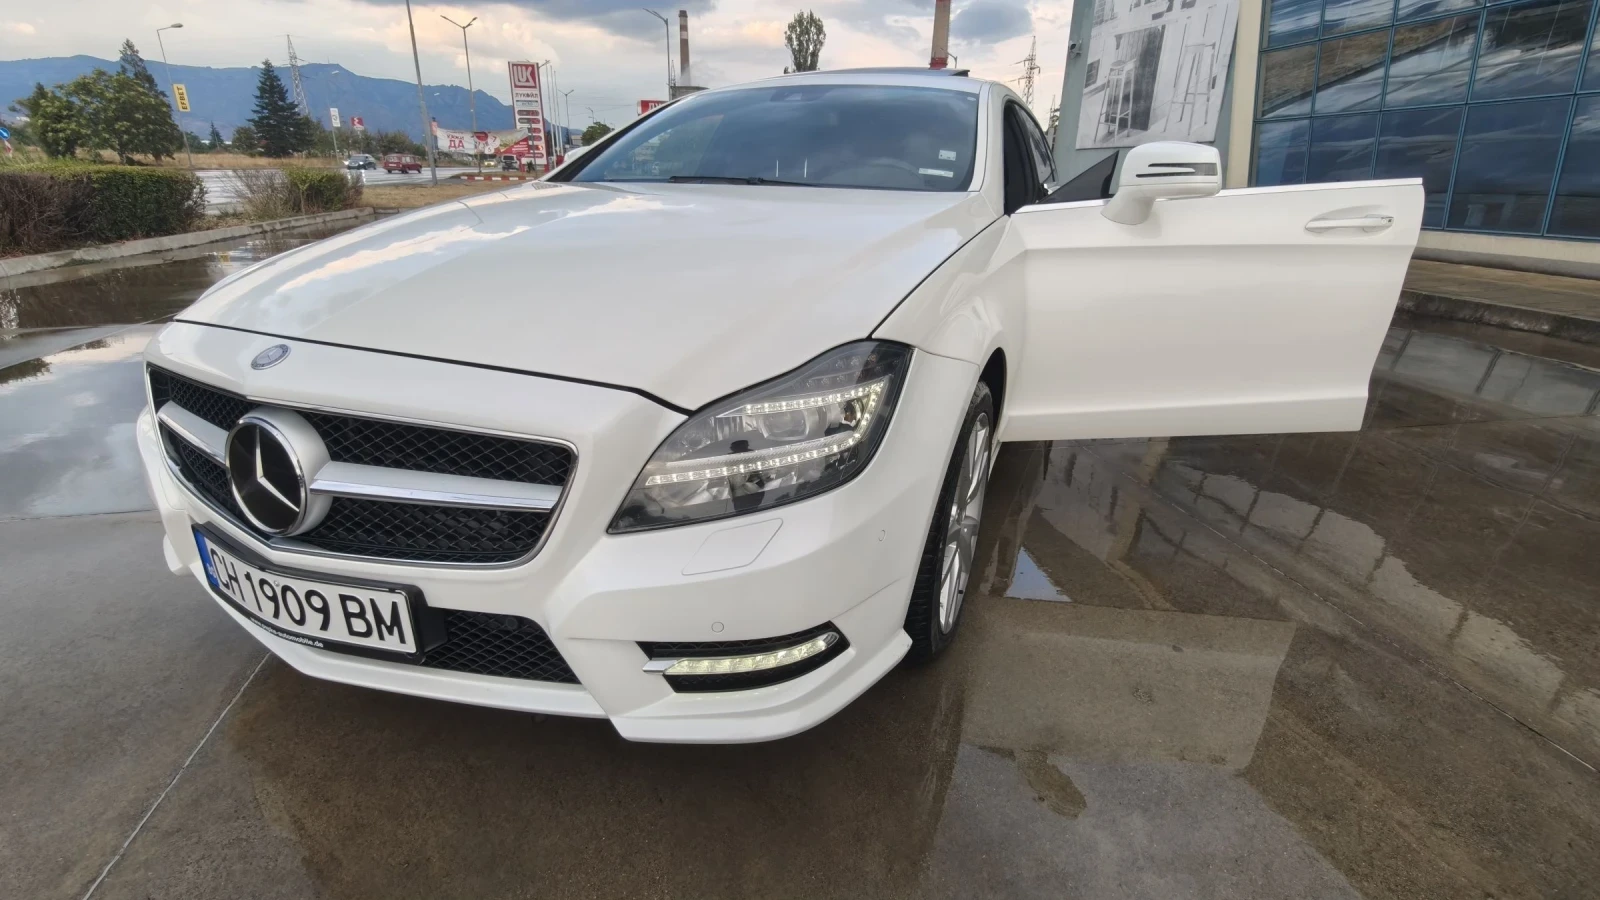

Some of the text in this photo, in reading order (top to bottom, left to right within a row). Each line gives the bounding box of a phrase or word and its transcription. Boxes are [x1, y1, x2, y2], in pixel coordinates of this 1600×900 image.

[176, 86, 188, 110] EFBET
[448, 139, 466, 150] ДА
[210, 548, 407, 645] CH 1909 BM
